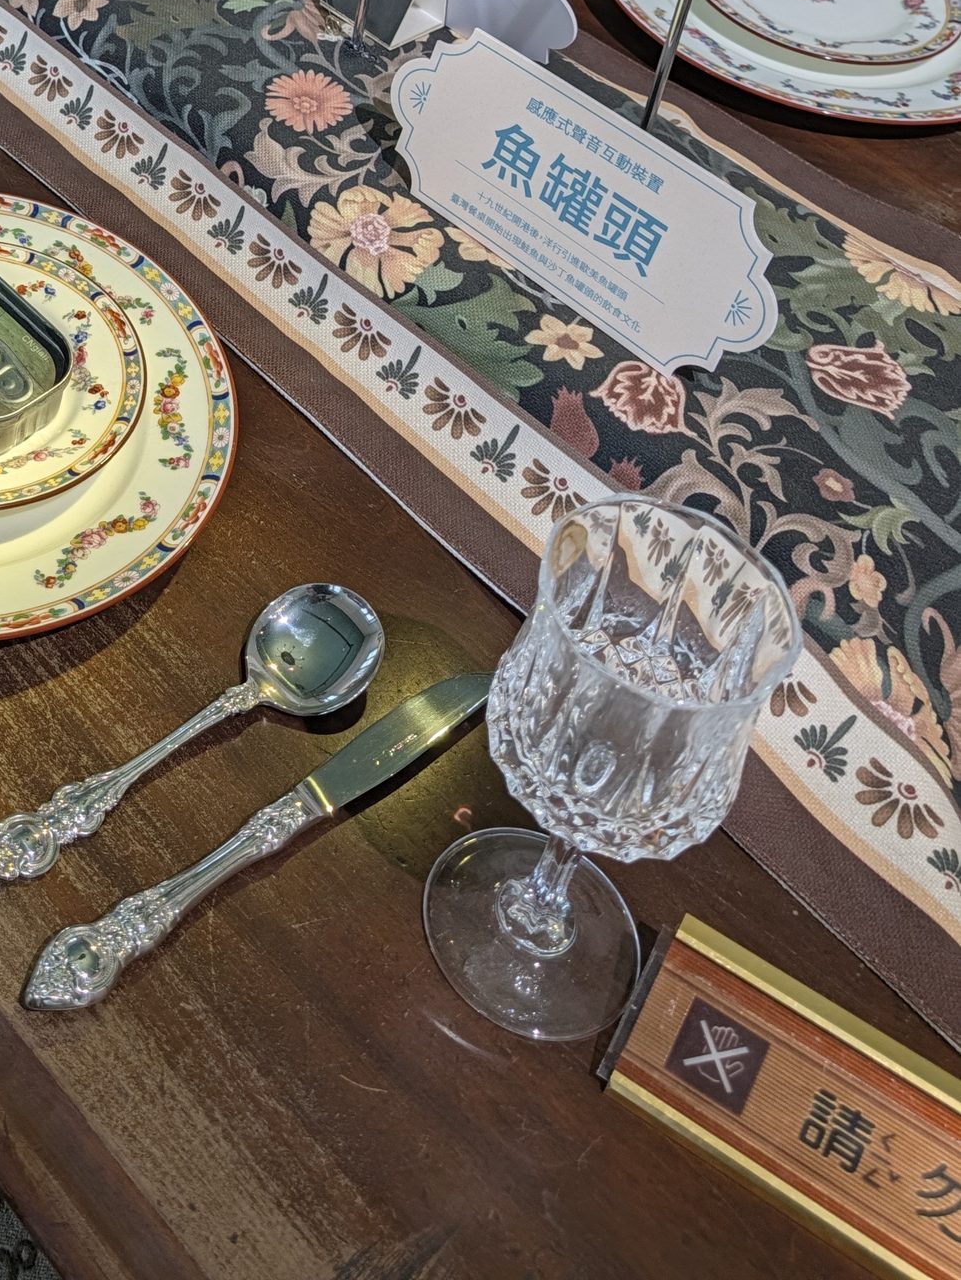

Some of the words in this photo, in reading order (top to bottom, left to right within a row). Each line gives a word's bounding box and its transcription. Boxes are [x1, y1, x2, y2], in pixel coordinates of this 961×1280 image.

[480, 123, 669, 278] 魚罐頭
[525, 96, 665, 195] 感應式聲音互動裝置
